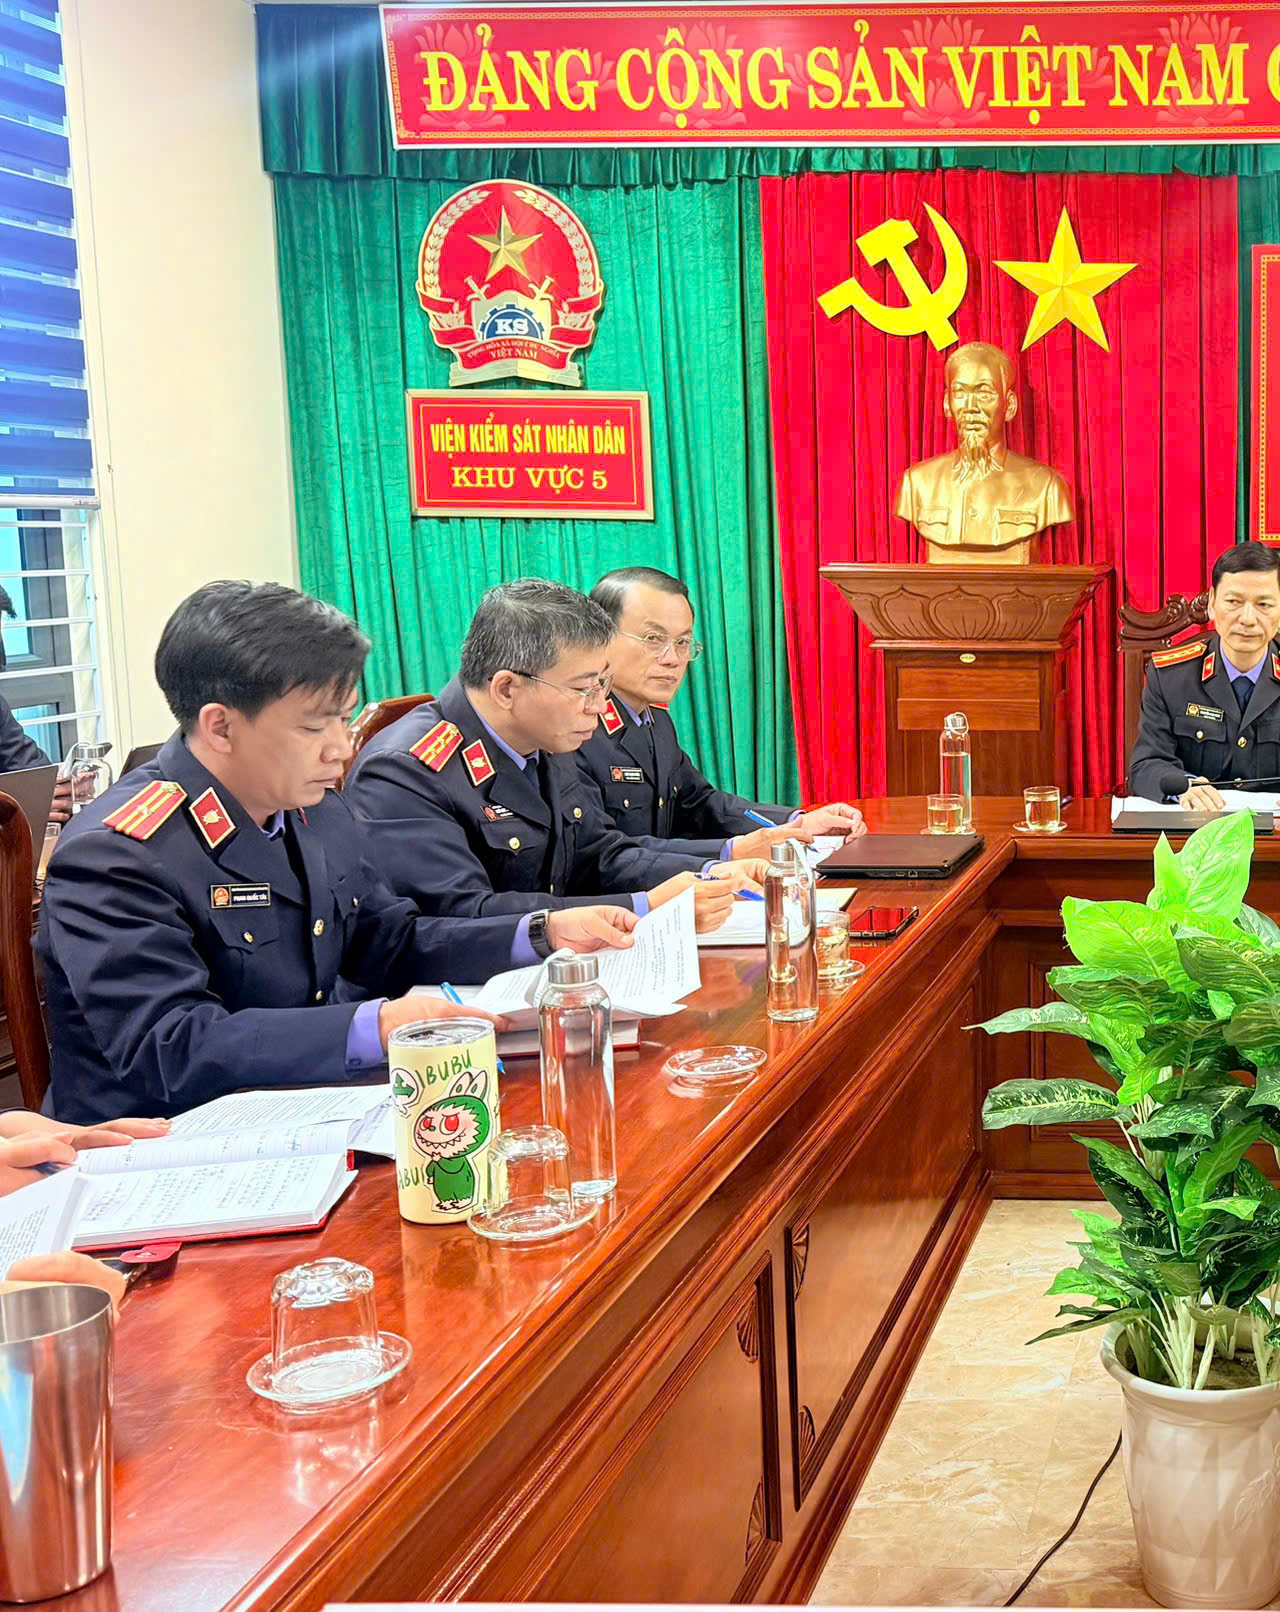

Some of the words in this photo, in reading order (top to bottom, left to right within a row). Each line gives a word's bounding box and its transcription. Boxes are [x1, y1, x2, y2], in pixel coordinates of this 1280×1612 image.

[420, 23, 598, 112] ĐẢNG
[615, 26, 790, 128] CỘNG
[808, 19, 926, 110] SẢN
[944, 25, 1093, 126] VIỆT
[1107, 42, 1250, 106] NAM
[495, 318, 529, 335] KS
[514, 348, 537, 359] NAM
[430, 417, 466, 459] VIỆN
[470, 412, 508, 453] KIỂM
[513, 418, 541, 453] SÁT
[545, 419, 588, 454] NHÂN
[593, 420, 625, 454] DÂN
[451, 467, 515, 488] KHU
[525, 465, 584, 494] VỰC
[592, 470, 608, 490] 5
